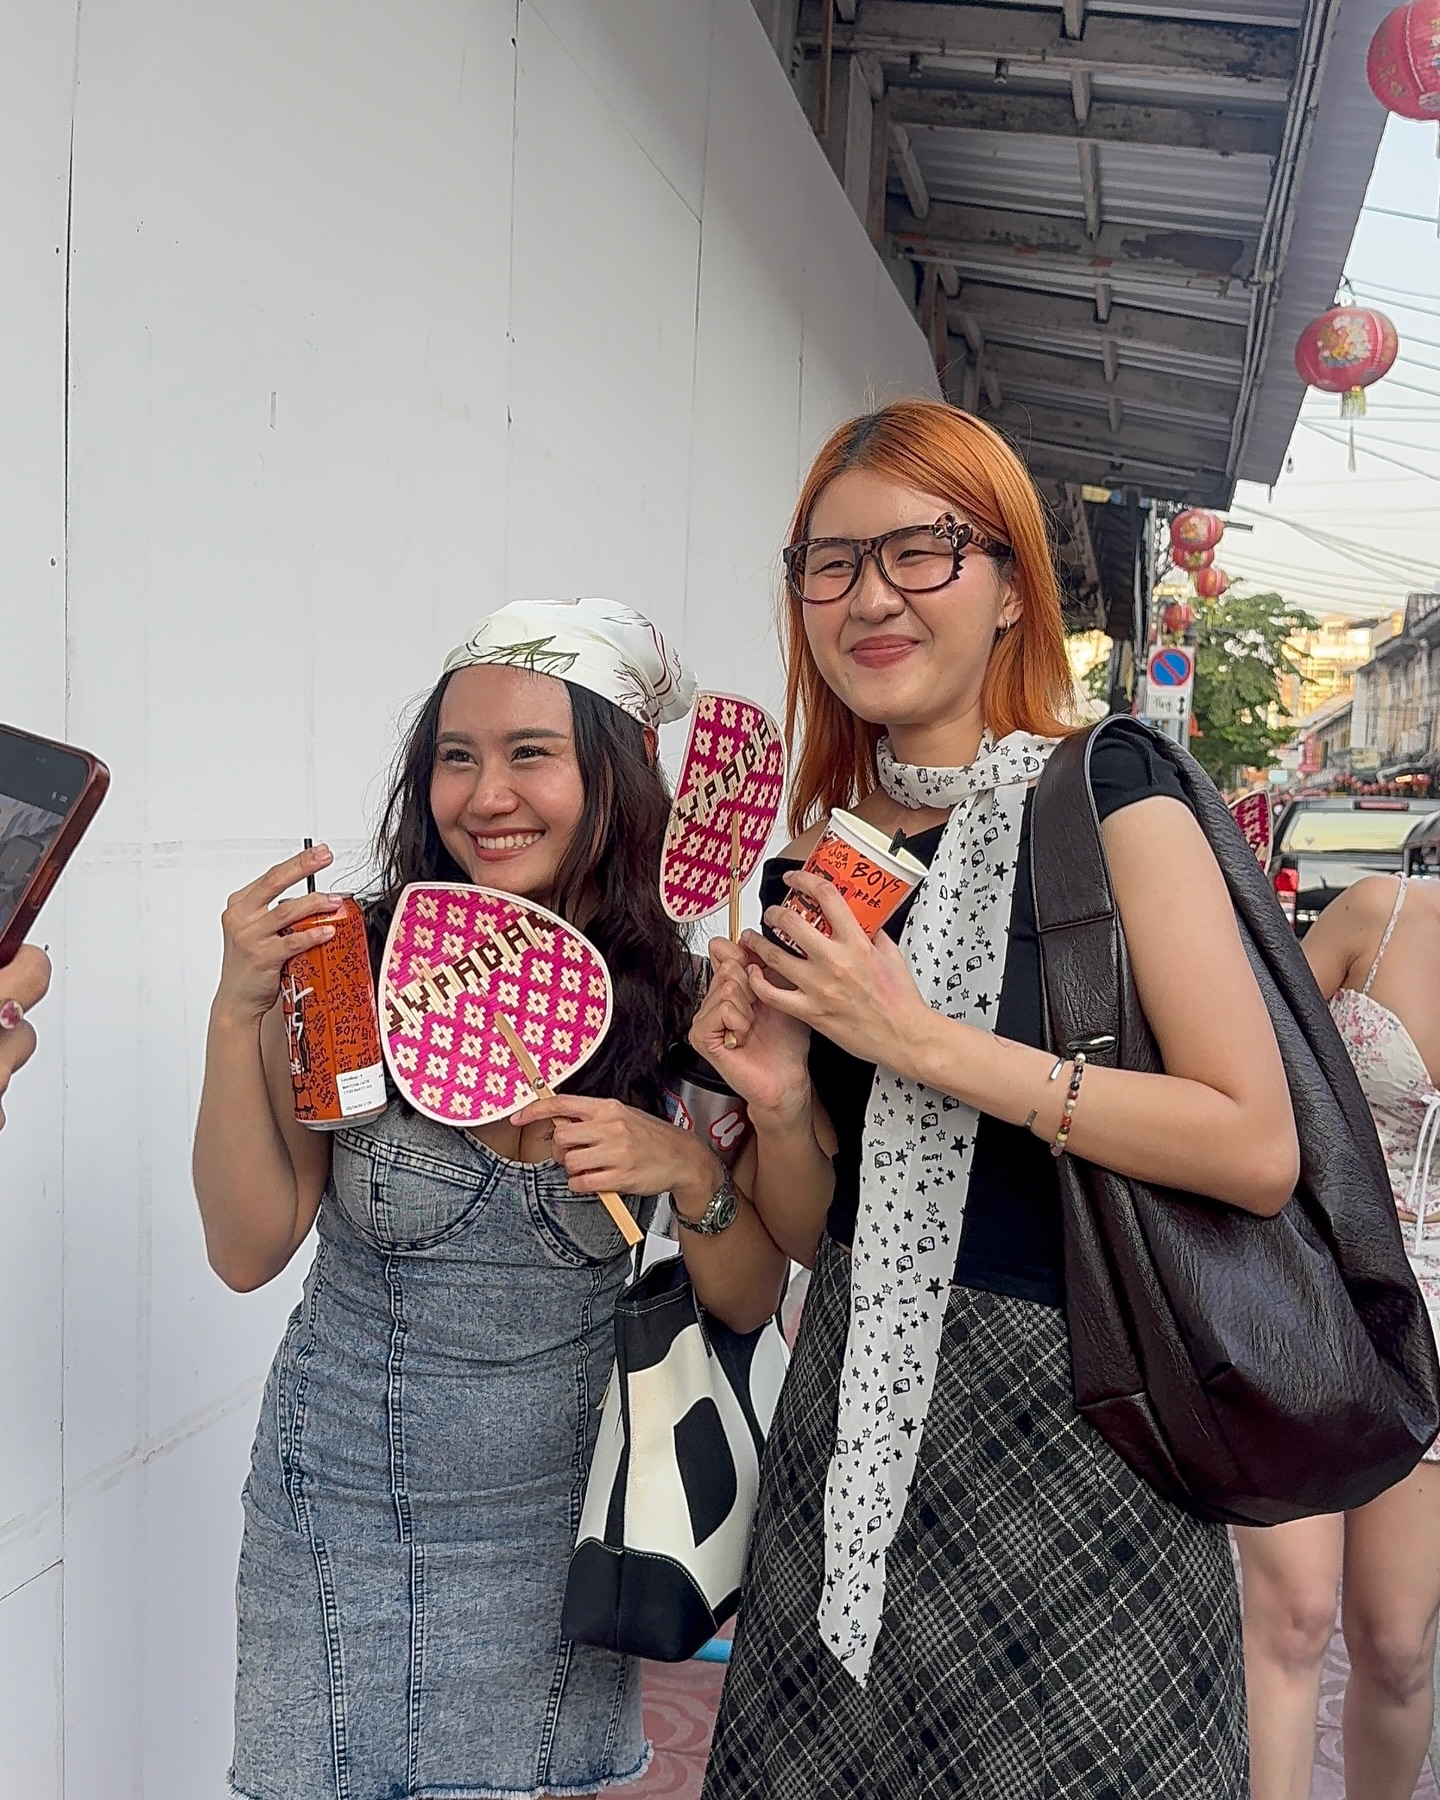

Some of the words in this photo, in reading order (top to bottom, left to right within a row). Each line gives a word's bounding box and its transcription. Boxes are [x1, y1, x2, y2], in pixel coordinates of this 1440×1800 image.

[851, 861, 904, 898] BOYS
[853, 888, 881, 908] FFEE
[334, 1014, 366, 1026] LOCAL
[335, 1024, 361, 1040] BOYS
